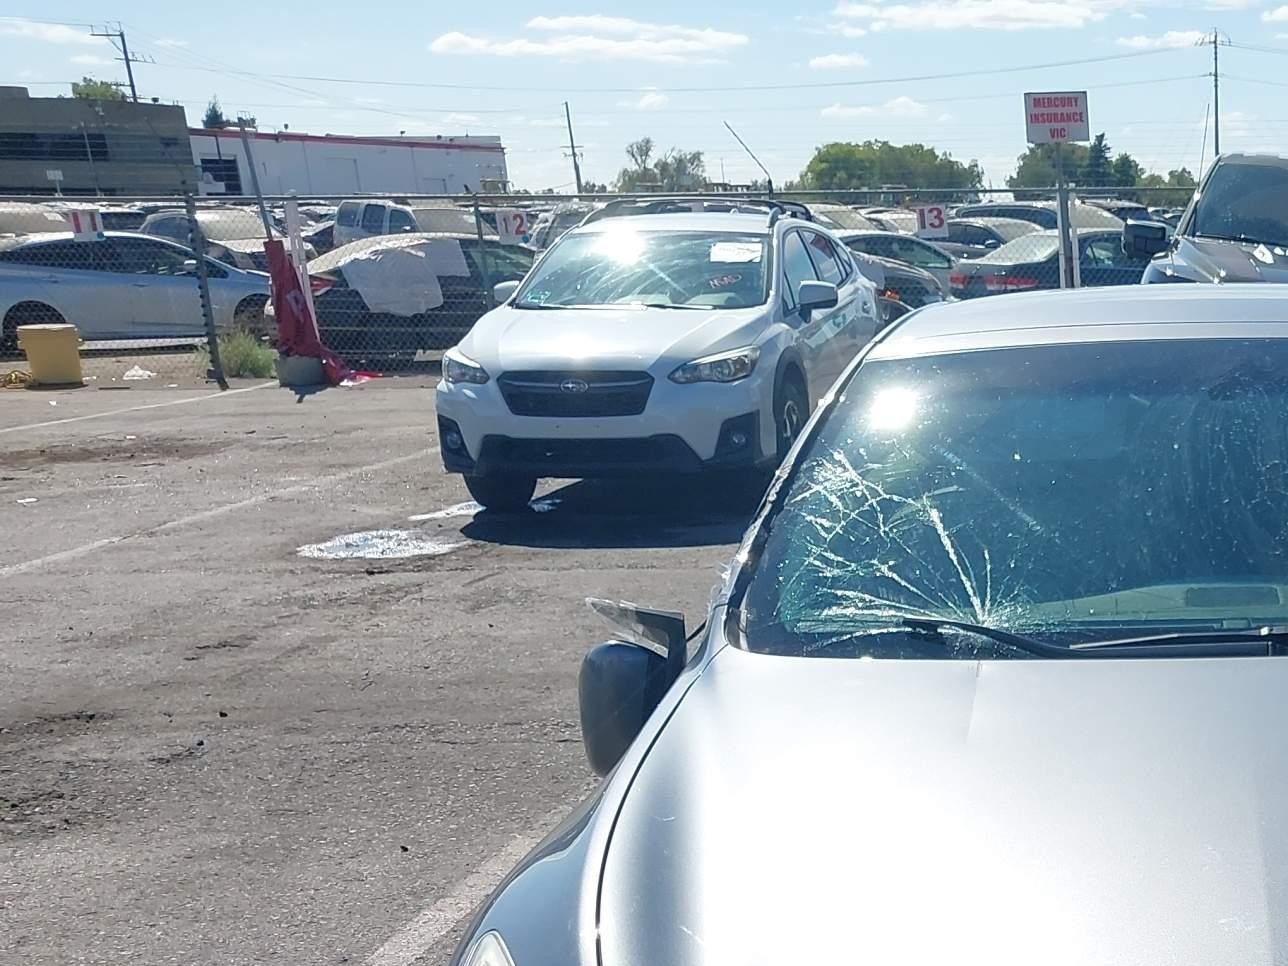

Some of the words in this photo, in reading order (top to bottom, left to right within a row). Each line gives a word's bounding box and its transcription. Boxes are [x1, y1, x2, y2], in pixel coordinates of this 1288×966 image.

[1032, 96, 1078, 108] MERCURY
[1030, 111, 1084, 124] INSURANCE
[1049, 127, 1066, 139] VIC
[502, 213, 527, 235] 12
[919, 207, 945, 230] 13
